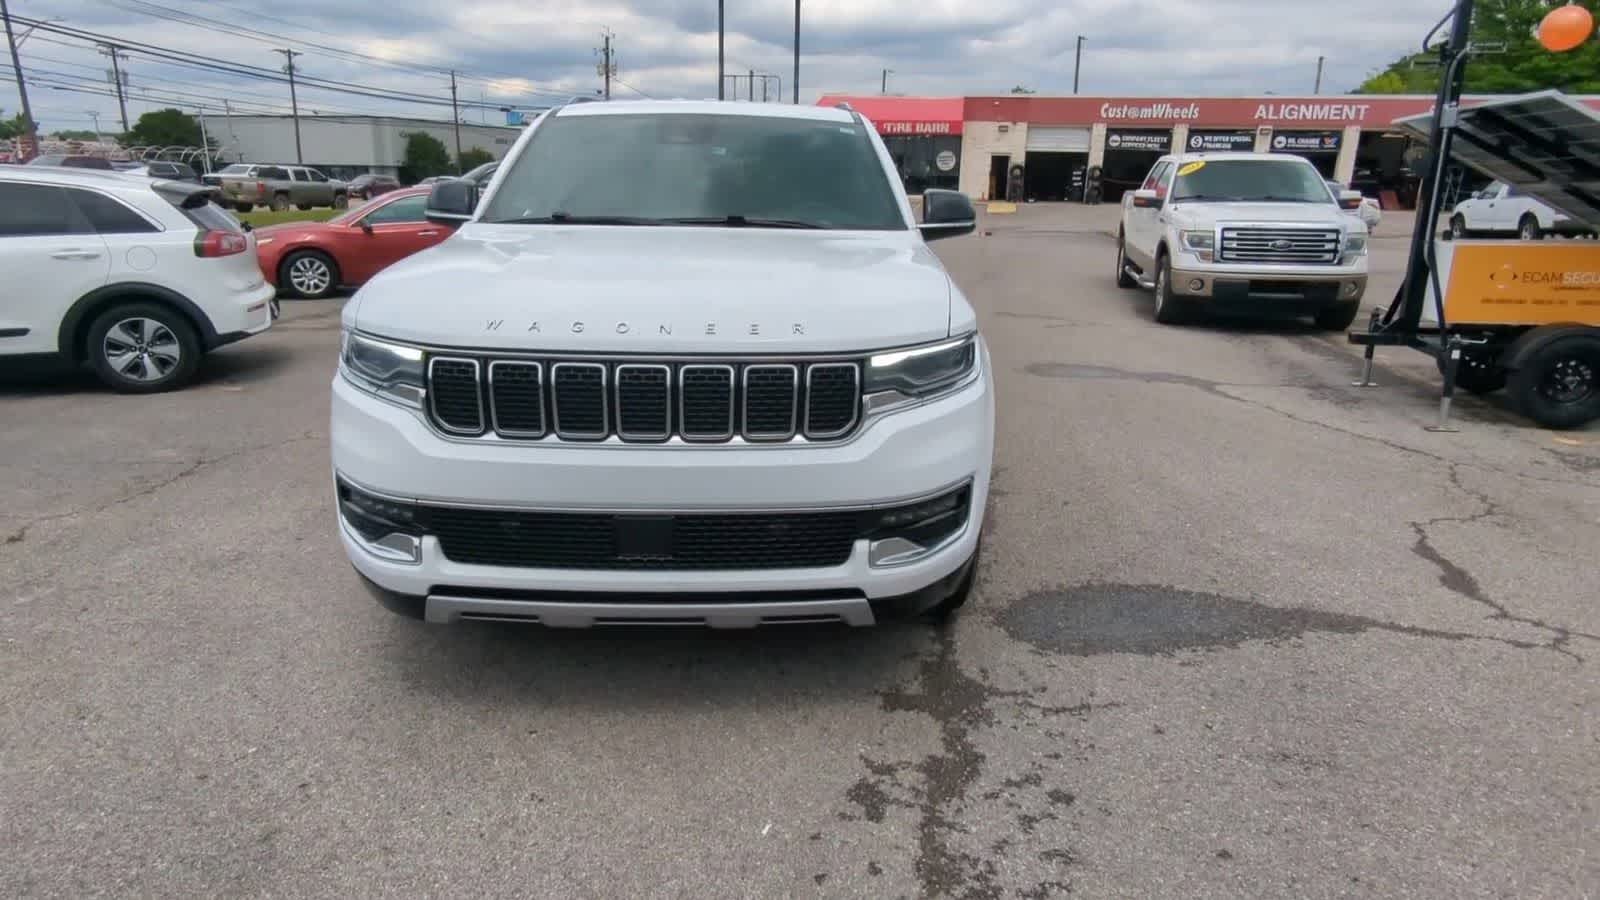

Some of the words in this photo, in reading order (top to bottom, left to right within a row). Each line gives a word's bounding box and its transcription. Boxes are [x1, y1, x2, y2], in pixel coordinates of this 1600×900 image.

[1254, 104, 1370, 121] ALIGNMENT
[915, 122, 950, 134] BARN
[484, 319, 810, 336] WAGONEER
